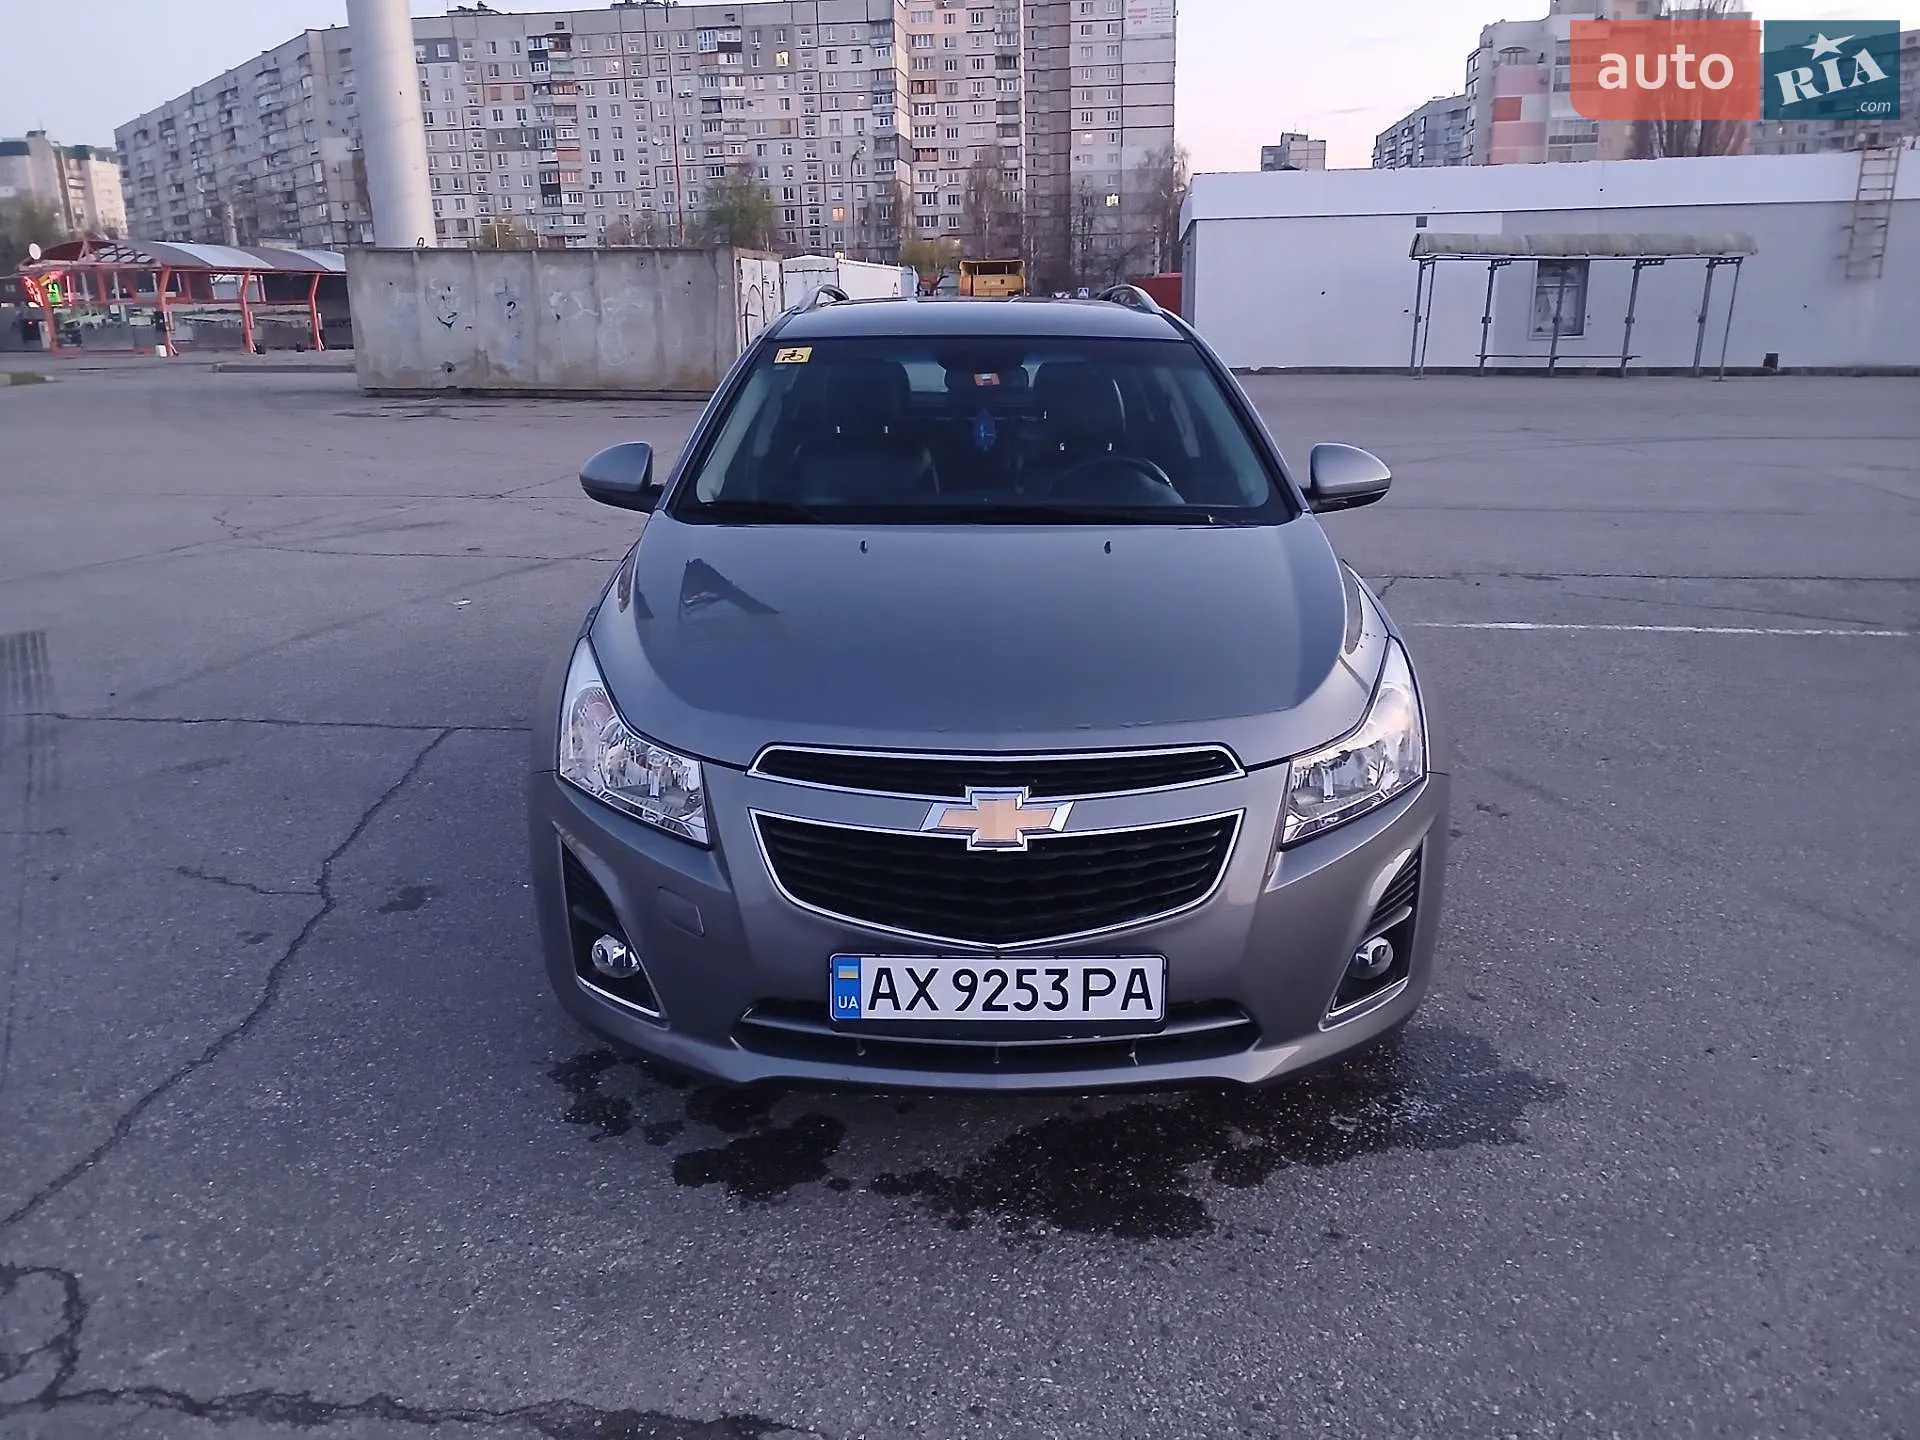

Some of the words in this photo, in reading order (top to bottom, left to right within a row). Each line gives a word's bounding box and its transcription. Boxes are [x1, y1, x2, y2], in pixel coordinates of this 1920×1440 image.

[838, 996, 858, 1009] UA
[868, 967, 939, 1011] AX
[952, 968, 1069, 1012] 9253
[1082, 967, 1153, 1011] PA
